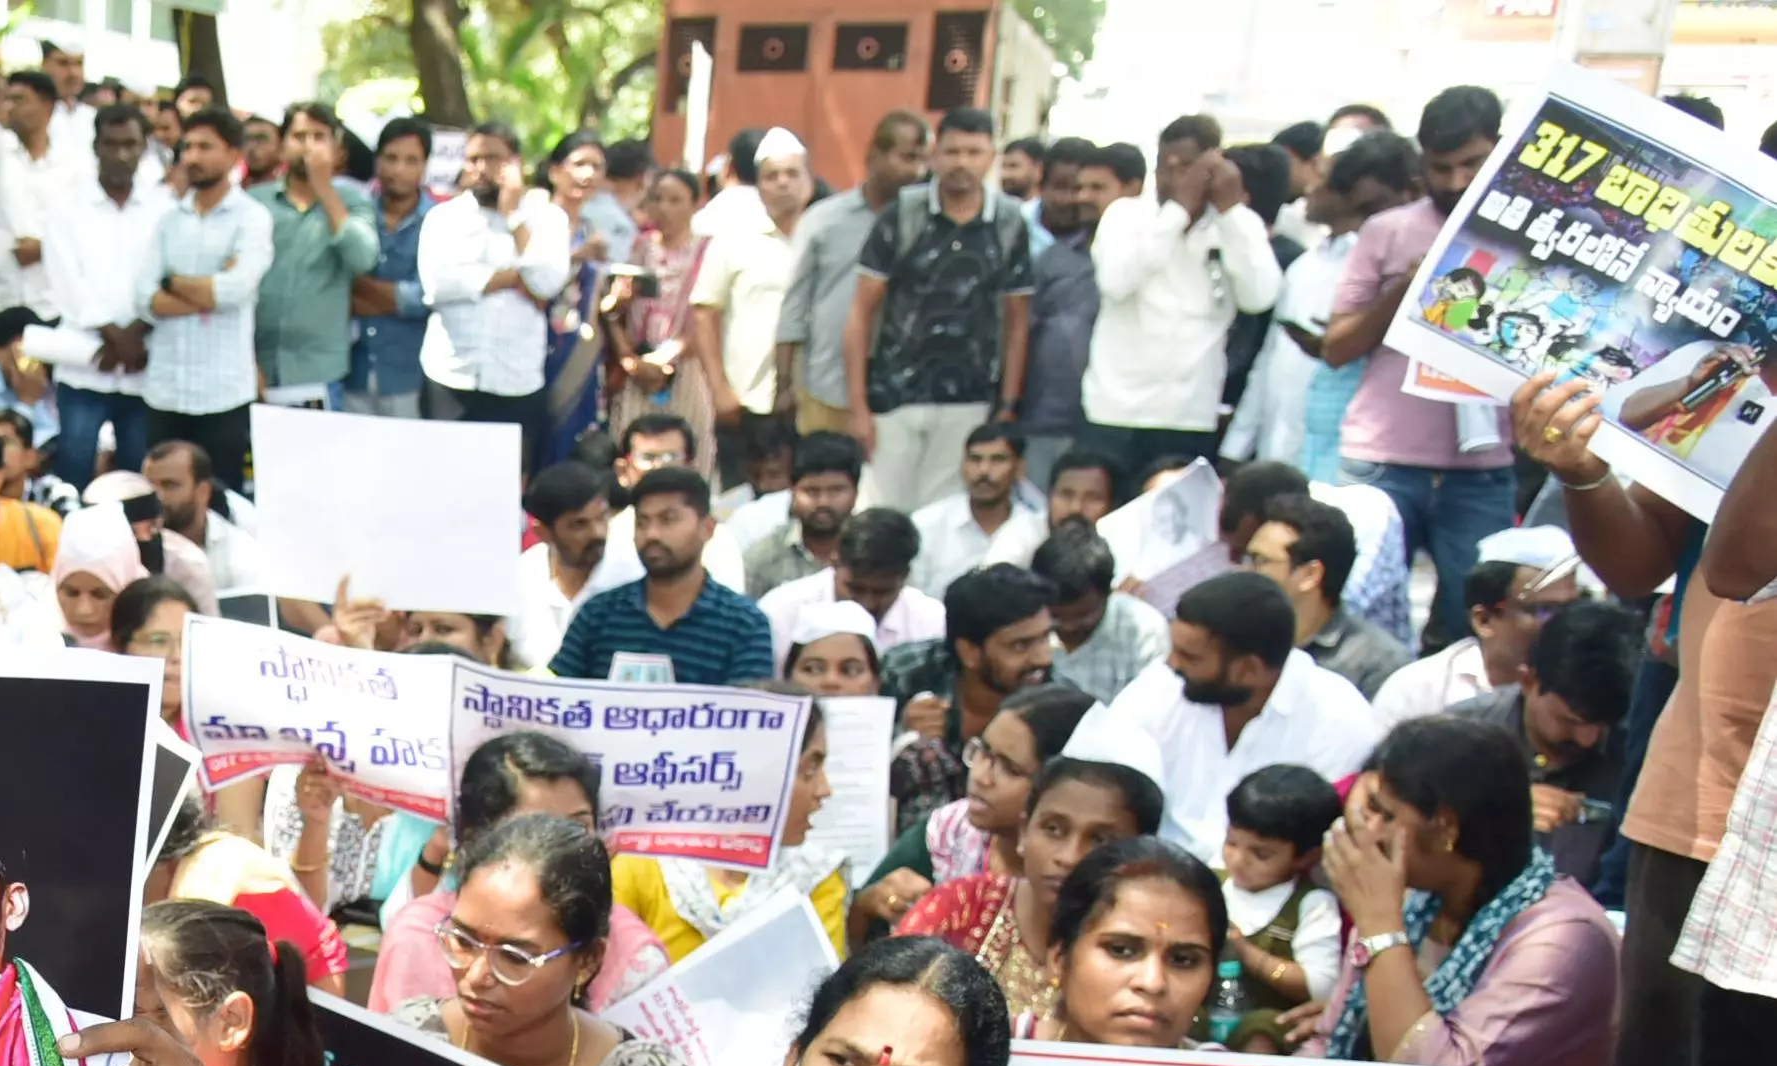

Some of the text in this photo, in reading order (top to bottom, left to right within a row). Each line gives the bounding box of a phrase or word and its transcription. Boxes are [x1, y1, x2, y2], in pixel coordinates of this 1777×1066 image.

[1518, 119, 1609, 183] 317
[1634, 266, 1742, 338] న్యాయం
[603, 702, 785, 736] ఆధారంగా
[613, 750, 744, 791] ఆఫీసర్స్
